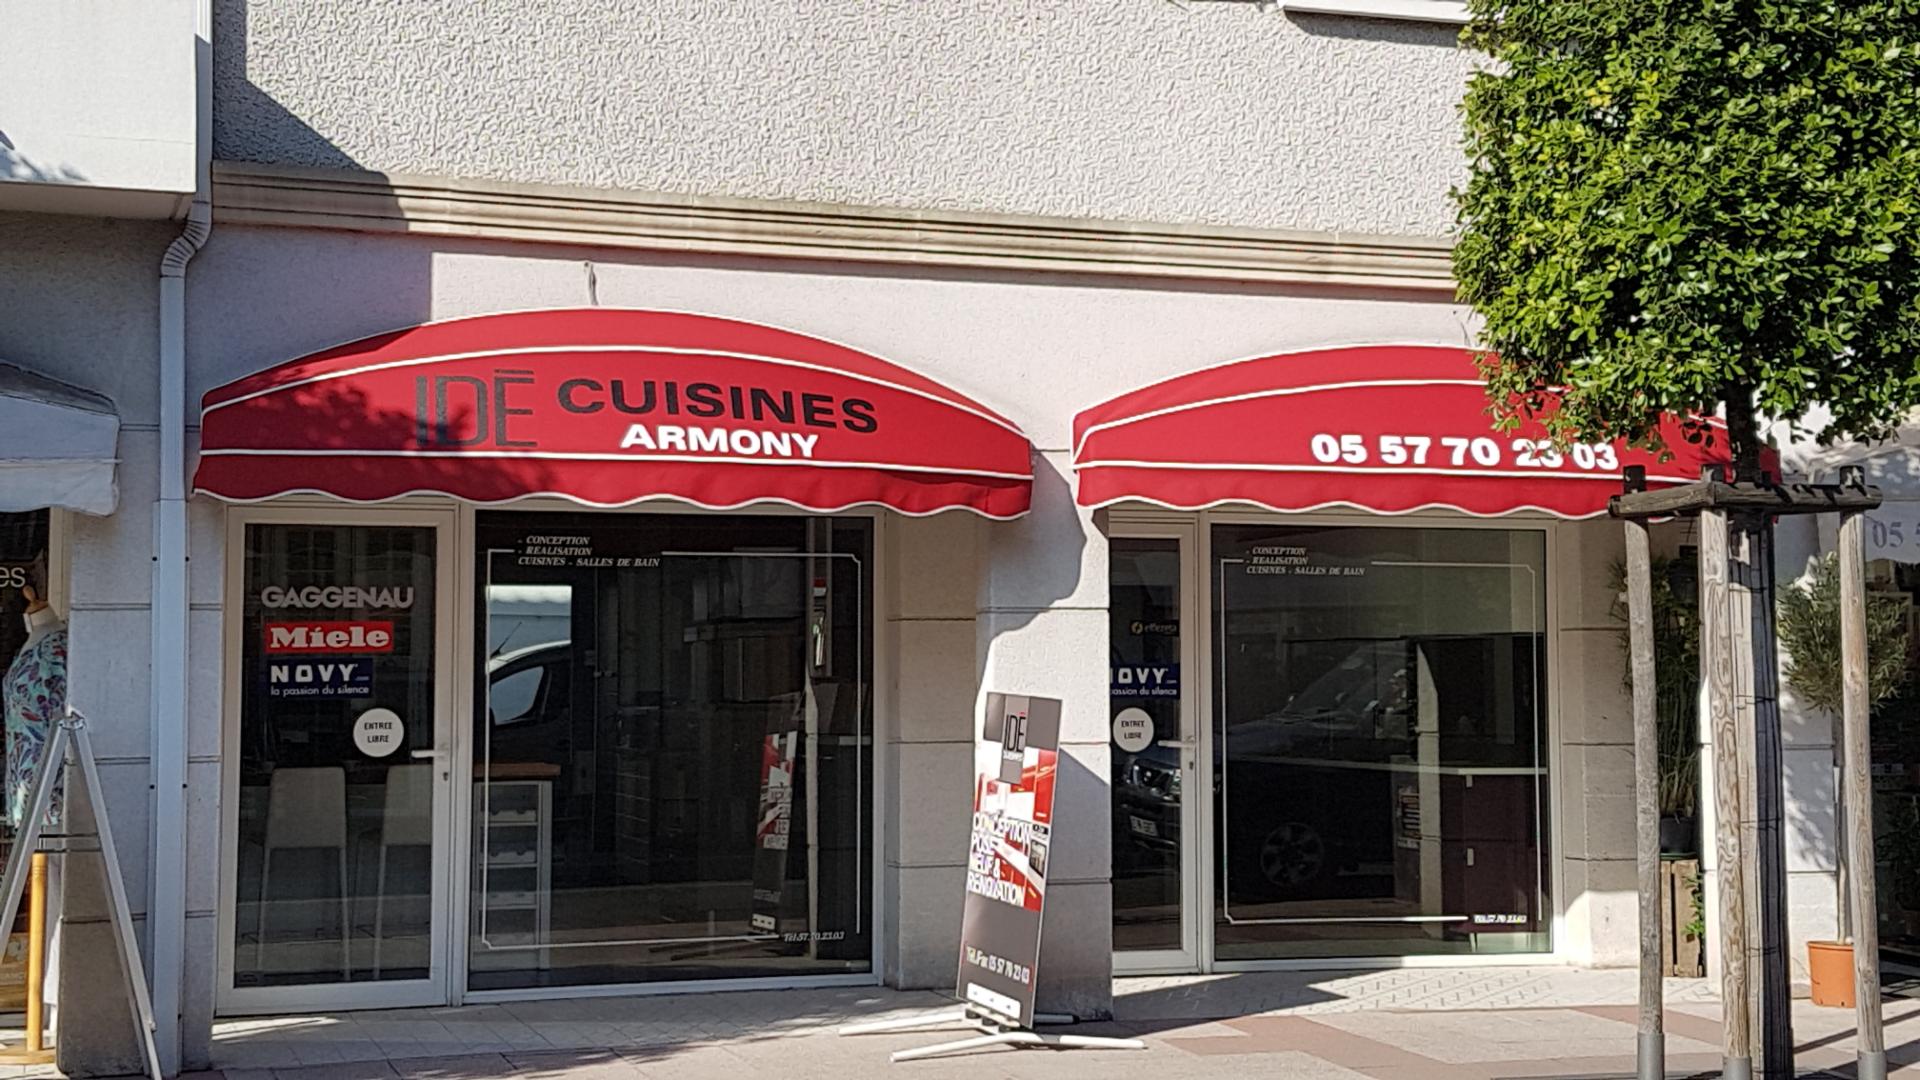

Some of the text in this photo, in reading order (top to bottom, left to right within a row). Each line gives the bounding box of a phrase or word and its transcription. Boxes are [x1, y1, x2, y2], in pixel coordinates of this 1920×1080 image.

[556, 378, 879, 434] CUISINES
[619, 423, 820, 458] ARMONY
[1310, 433, 1619, 470] 05 57 70 23 03
[526, 535, 591, 545] CONCEPTION
[1872, 521, 1904, 549] 05
[1252, 546, 1307, 556] CONCEPTION
[518, 556, 567, 566] CUISINES
[576, 557, 614, 567] SALLES
[617, 558, 631, 567] DE
[634, 558, 660, 567] BAIN
[1246, 565, 1287, 575] CUISINES
[1295, 566, 1327, 575] SALLES
[1329, 567, 1341, 575] DE
[1344, 567, 1366, 576] BAIN
[261, 585, 414, 609] GAGGENAU
[270, 626, 390, 649] Miele
[270, 663, 356, 683] NOVY
[270, 684, 370, 698] la passion du silence
[1140, 685, 1150, 696] du
[1151, 686, 1177, 696] silence
[367, 734, 390, 743] LIBRE
[1124, 731, 1142, 740] LIBRE
[973, 812, 1031, 846] CONCEPTION
[971, 832, 999, 856] POSE
